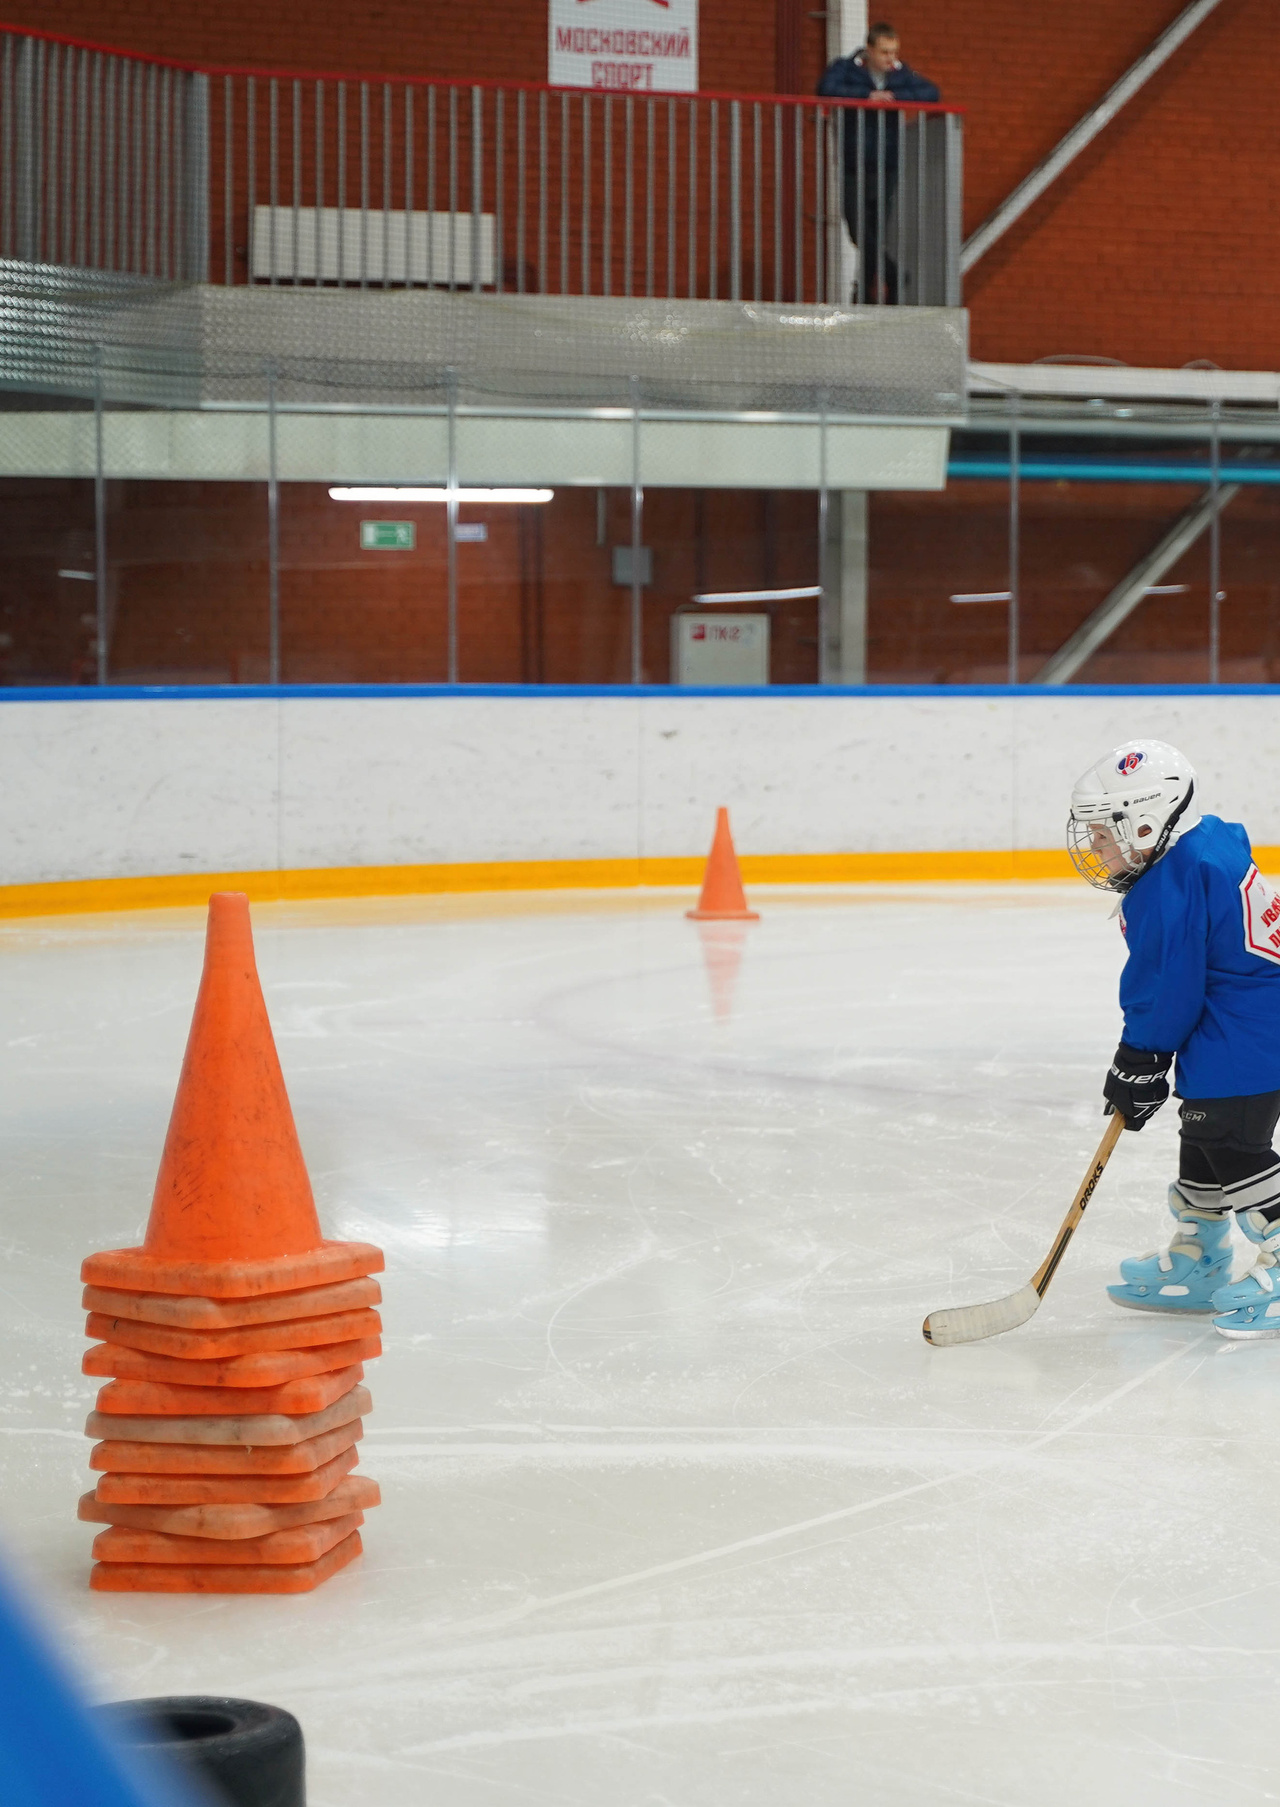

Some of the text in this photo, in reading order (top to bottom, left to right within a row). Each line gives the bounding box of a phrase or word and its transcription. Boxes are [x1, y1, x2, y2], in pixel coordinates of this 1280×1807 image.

[555, 26, 690, 57] МОСКОВСКИЙ
[591, 61, 654, 89] СПОРТ
[1110, 1063, 1167, 1084] AUER
[1079, 1161, 1104, 1211] OROKS
